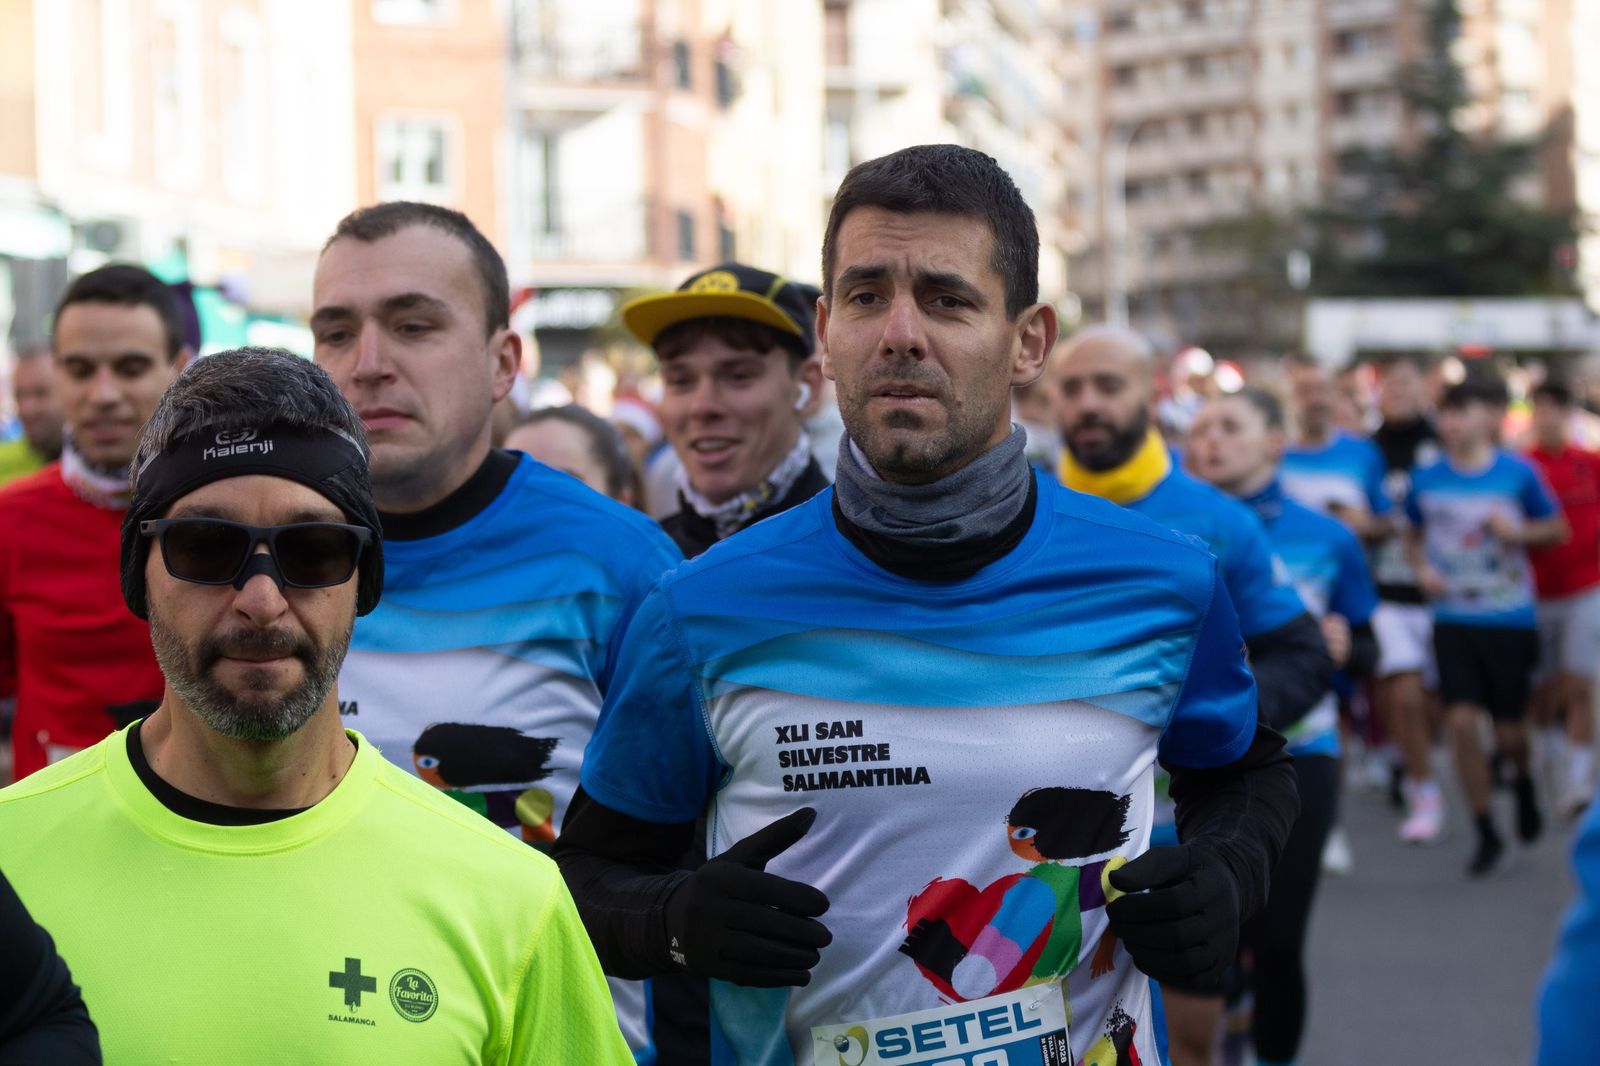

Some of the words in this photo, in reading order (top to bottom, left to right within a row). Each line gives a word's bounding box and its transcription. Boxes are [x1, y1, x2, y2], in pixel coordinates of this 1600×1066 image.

[203, 440, 274, 461] Kalenji
[775, 723, 809, 744] XLI
[815, 720, 863, 740] SAN
[778, 743, 890, 768] SILVESTRE
[782, 766, 931, 792] SALMANTINA
[406, 976, 419, 990] La
[395, 986, 433, 1003] Favorita
[328, 1014, 376, 1027] SALAMANCA
[875, 1002, 1042, 1059] SETEL
